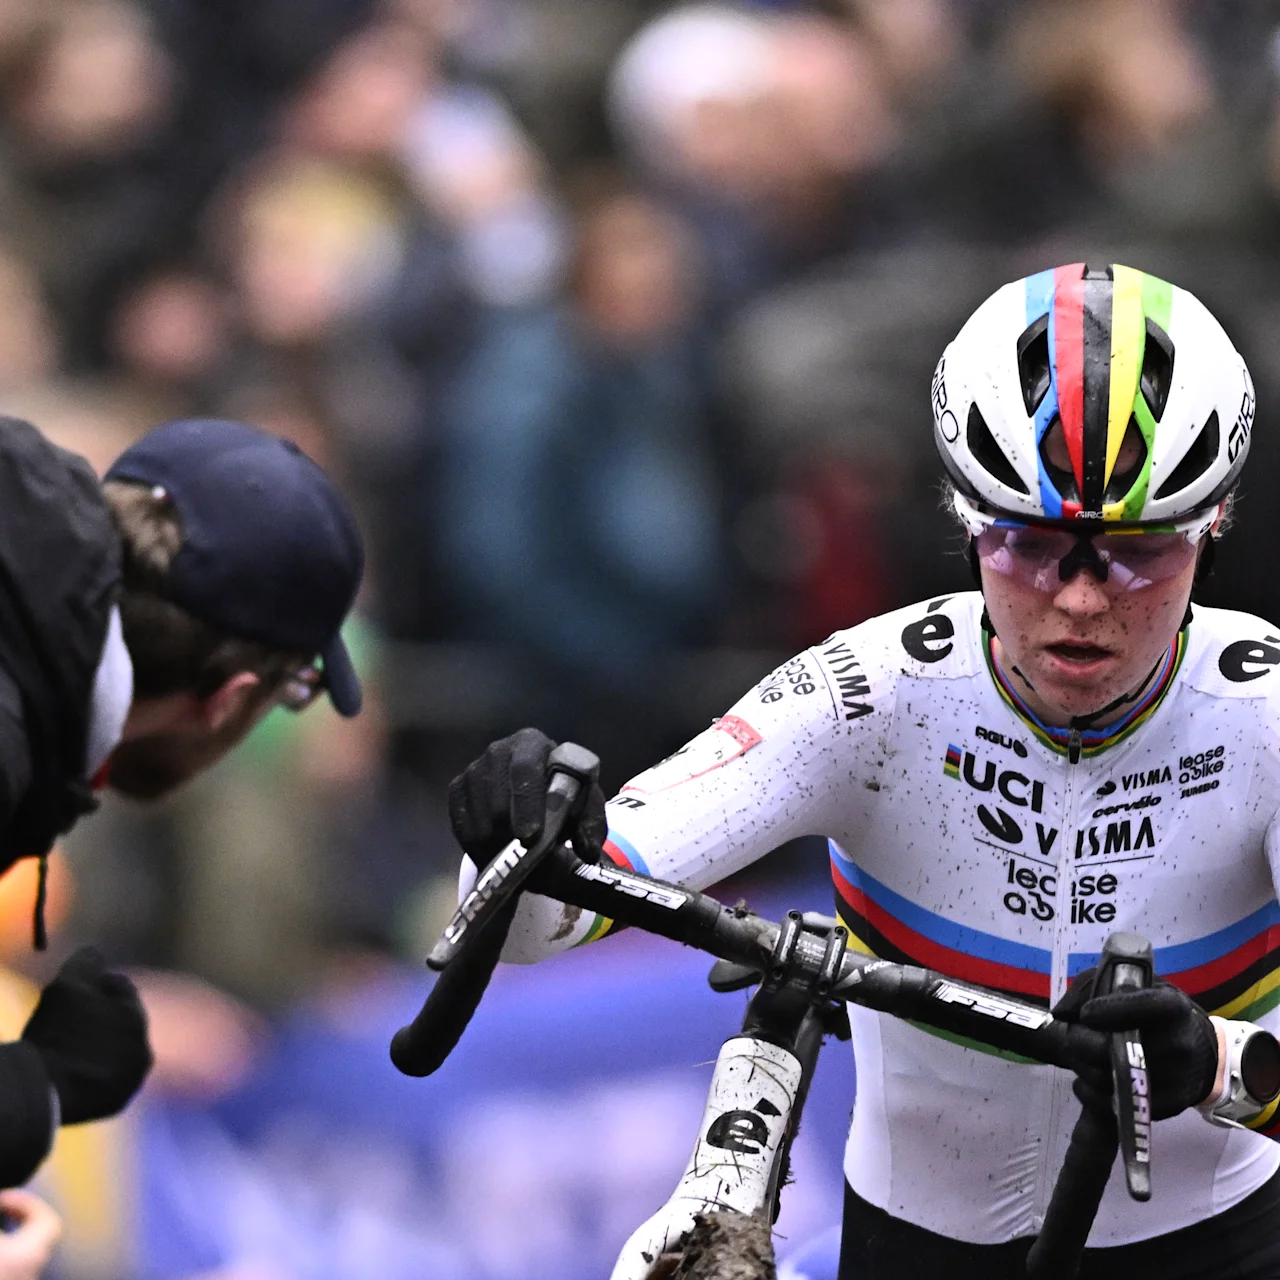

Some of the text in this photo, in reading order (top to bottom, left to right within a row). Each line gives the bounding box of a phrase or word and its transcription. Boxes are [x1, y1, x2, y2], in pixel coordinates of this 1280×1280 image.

[822, 641, 875, 721] VISMA
[974, 725, 1014, 750] AGU
[1178, 745, 1225, 771] lease
[963, 751, 1045, 814] UCI
[1121, 765, 1173, 792] VISMA
[1179, 779, 1220, 800] JUMBO
[443, 837, 529, 945] SRAM
[1126, 1041, 1152, 1163] SRAM
